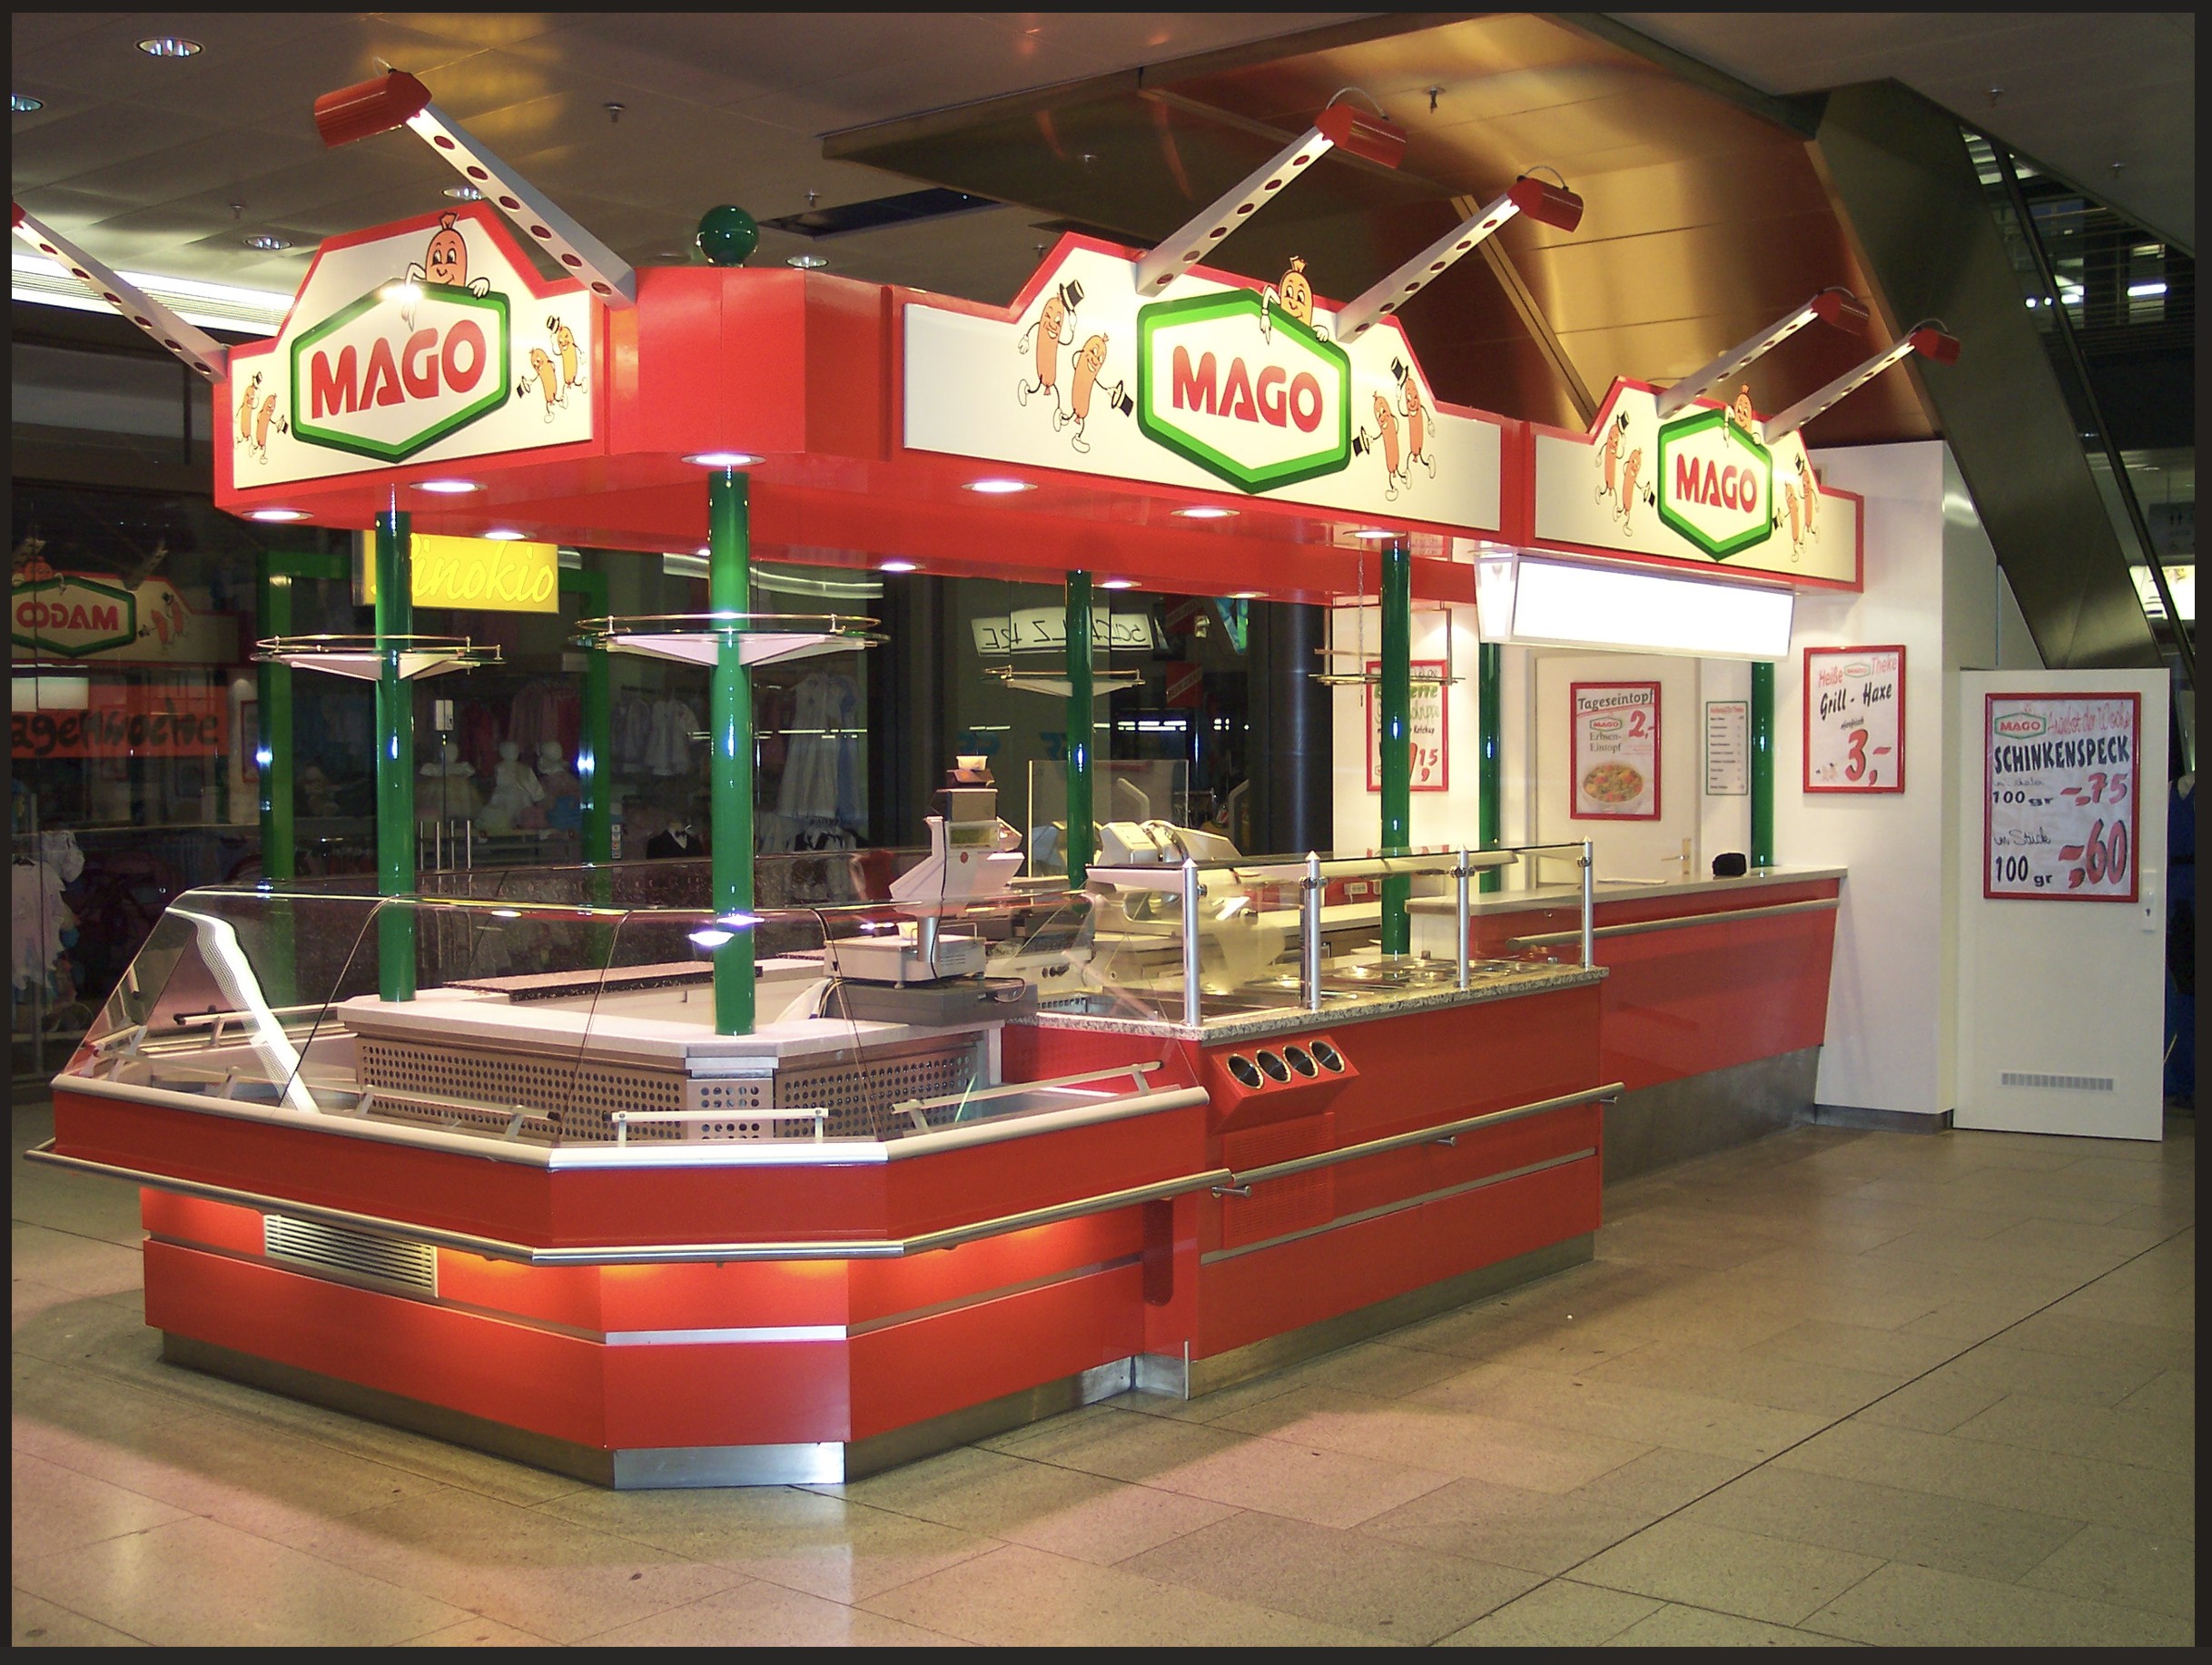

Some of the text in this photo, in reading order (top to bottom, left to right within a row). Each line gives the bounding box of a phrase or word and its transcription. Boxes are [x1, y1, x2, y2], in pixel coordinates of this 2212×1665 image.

[311, 320, 486, 419] MAGO
[1173, 346, 1323, 433] MAGO
[1676, 453, 1757, 514] MAGO
[370, 533, 555, 603] inokio
[1578, 689, 1654, 712] Tageseintopf
[1821, 687, 1847, 721] Grill
[1863, 682, 1892, 707] Haxe
[2000, 721, 2041, 732] MAGO
[1590, 743, 1621, 754] Eintopf
[1994, 734, 2130, 773] SCHINKENSPECK
[1992, 791, 2025, 803] 100
[1996, 855, 2029, 882] 100
[2034, 872, 2053, 887] gr
